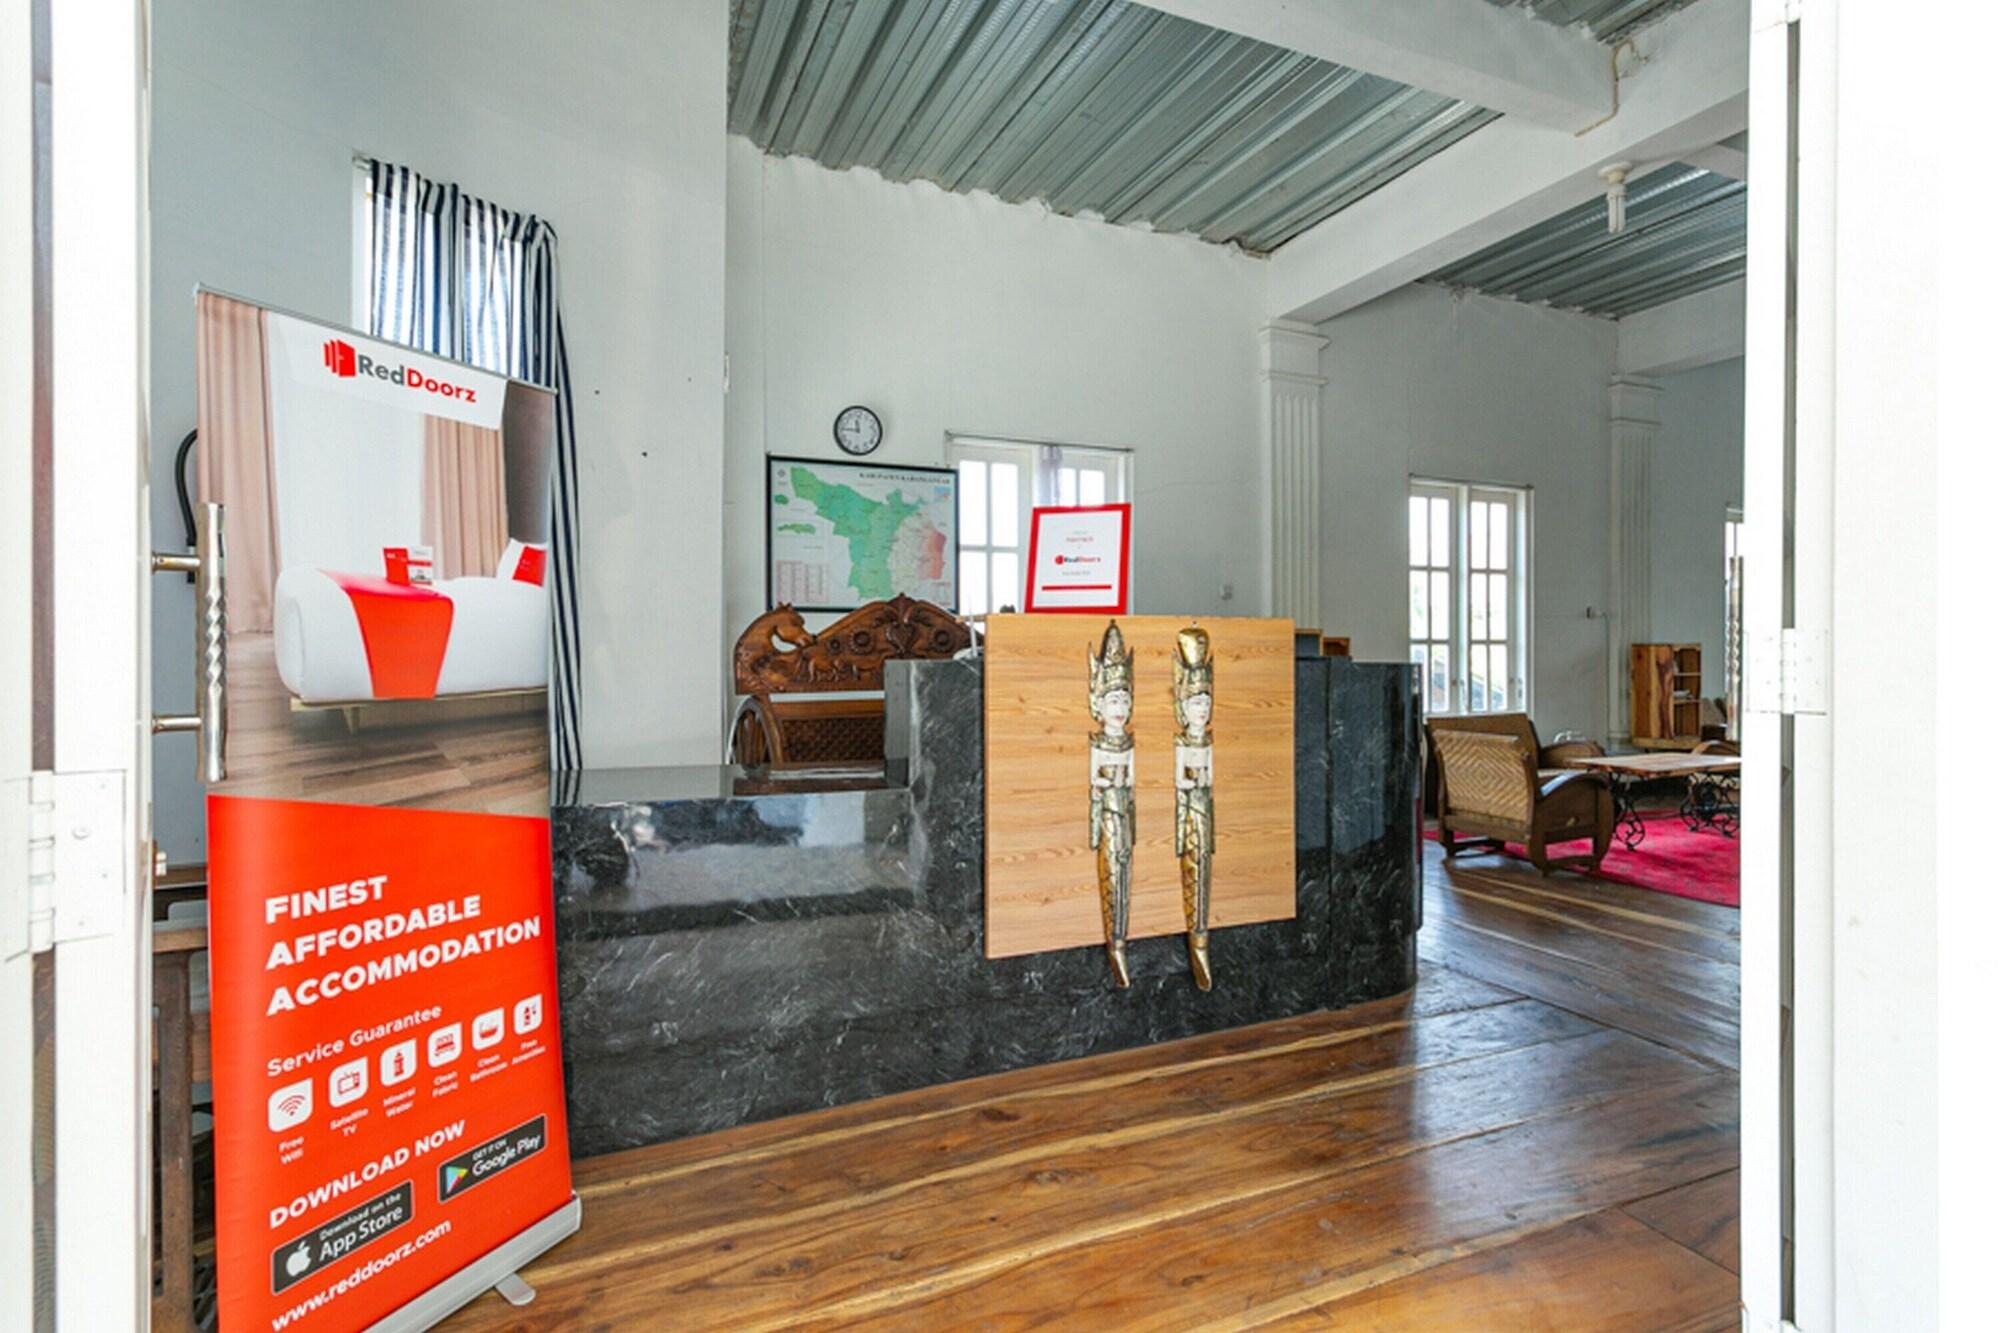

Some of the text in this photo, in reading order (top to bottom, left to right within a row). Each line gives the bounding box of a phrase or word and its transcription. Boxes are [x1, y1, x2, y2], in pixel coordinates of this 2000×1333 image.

[357, 354, 477, 403] RedDoorz
[265, 875, 388, 924] FINEST
[265, 895, 481, 970] AFFORDABLE
[266, 916, 540, 1016] ACCOMMODATION
[267, 1005, 443, 1076] Service Guarantee
[383, 1087, 416, 1106] Mineral
[432, 1081, 459, 1097] Fabric
[433, 1071, 458, 1086] Clean
[330, 1108, 369, 1130] Satellite
[342, 1124, 357, 1136] TV
[385, 1101, 414, 1118] Water
[279, 1136, 304, 1152] Free
[472, 1147, 488, 1161] GET
[495, 1138, 507, 1149] ON
[472, 1135, 541, 1177] Google Play
[270, 1120, 465, 1229] DOWNLOAD NOW
[319, 1191, 402, 1241] Download on the
[319, 1205, 403, 1262] App Store
[271, 1219, 452, 1333] www.reddoorz.com
